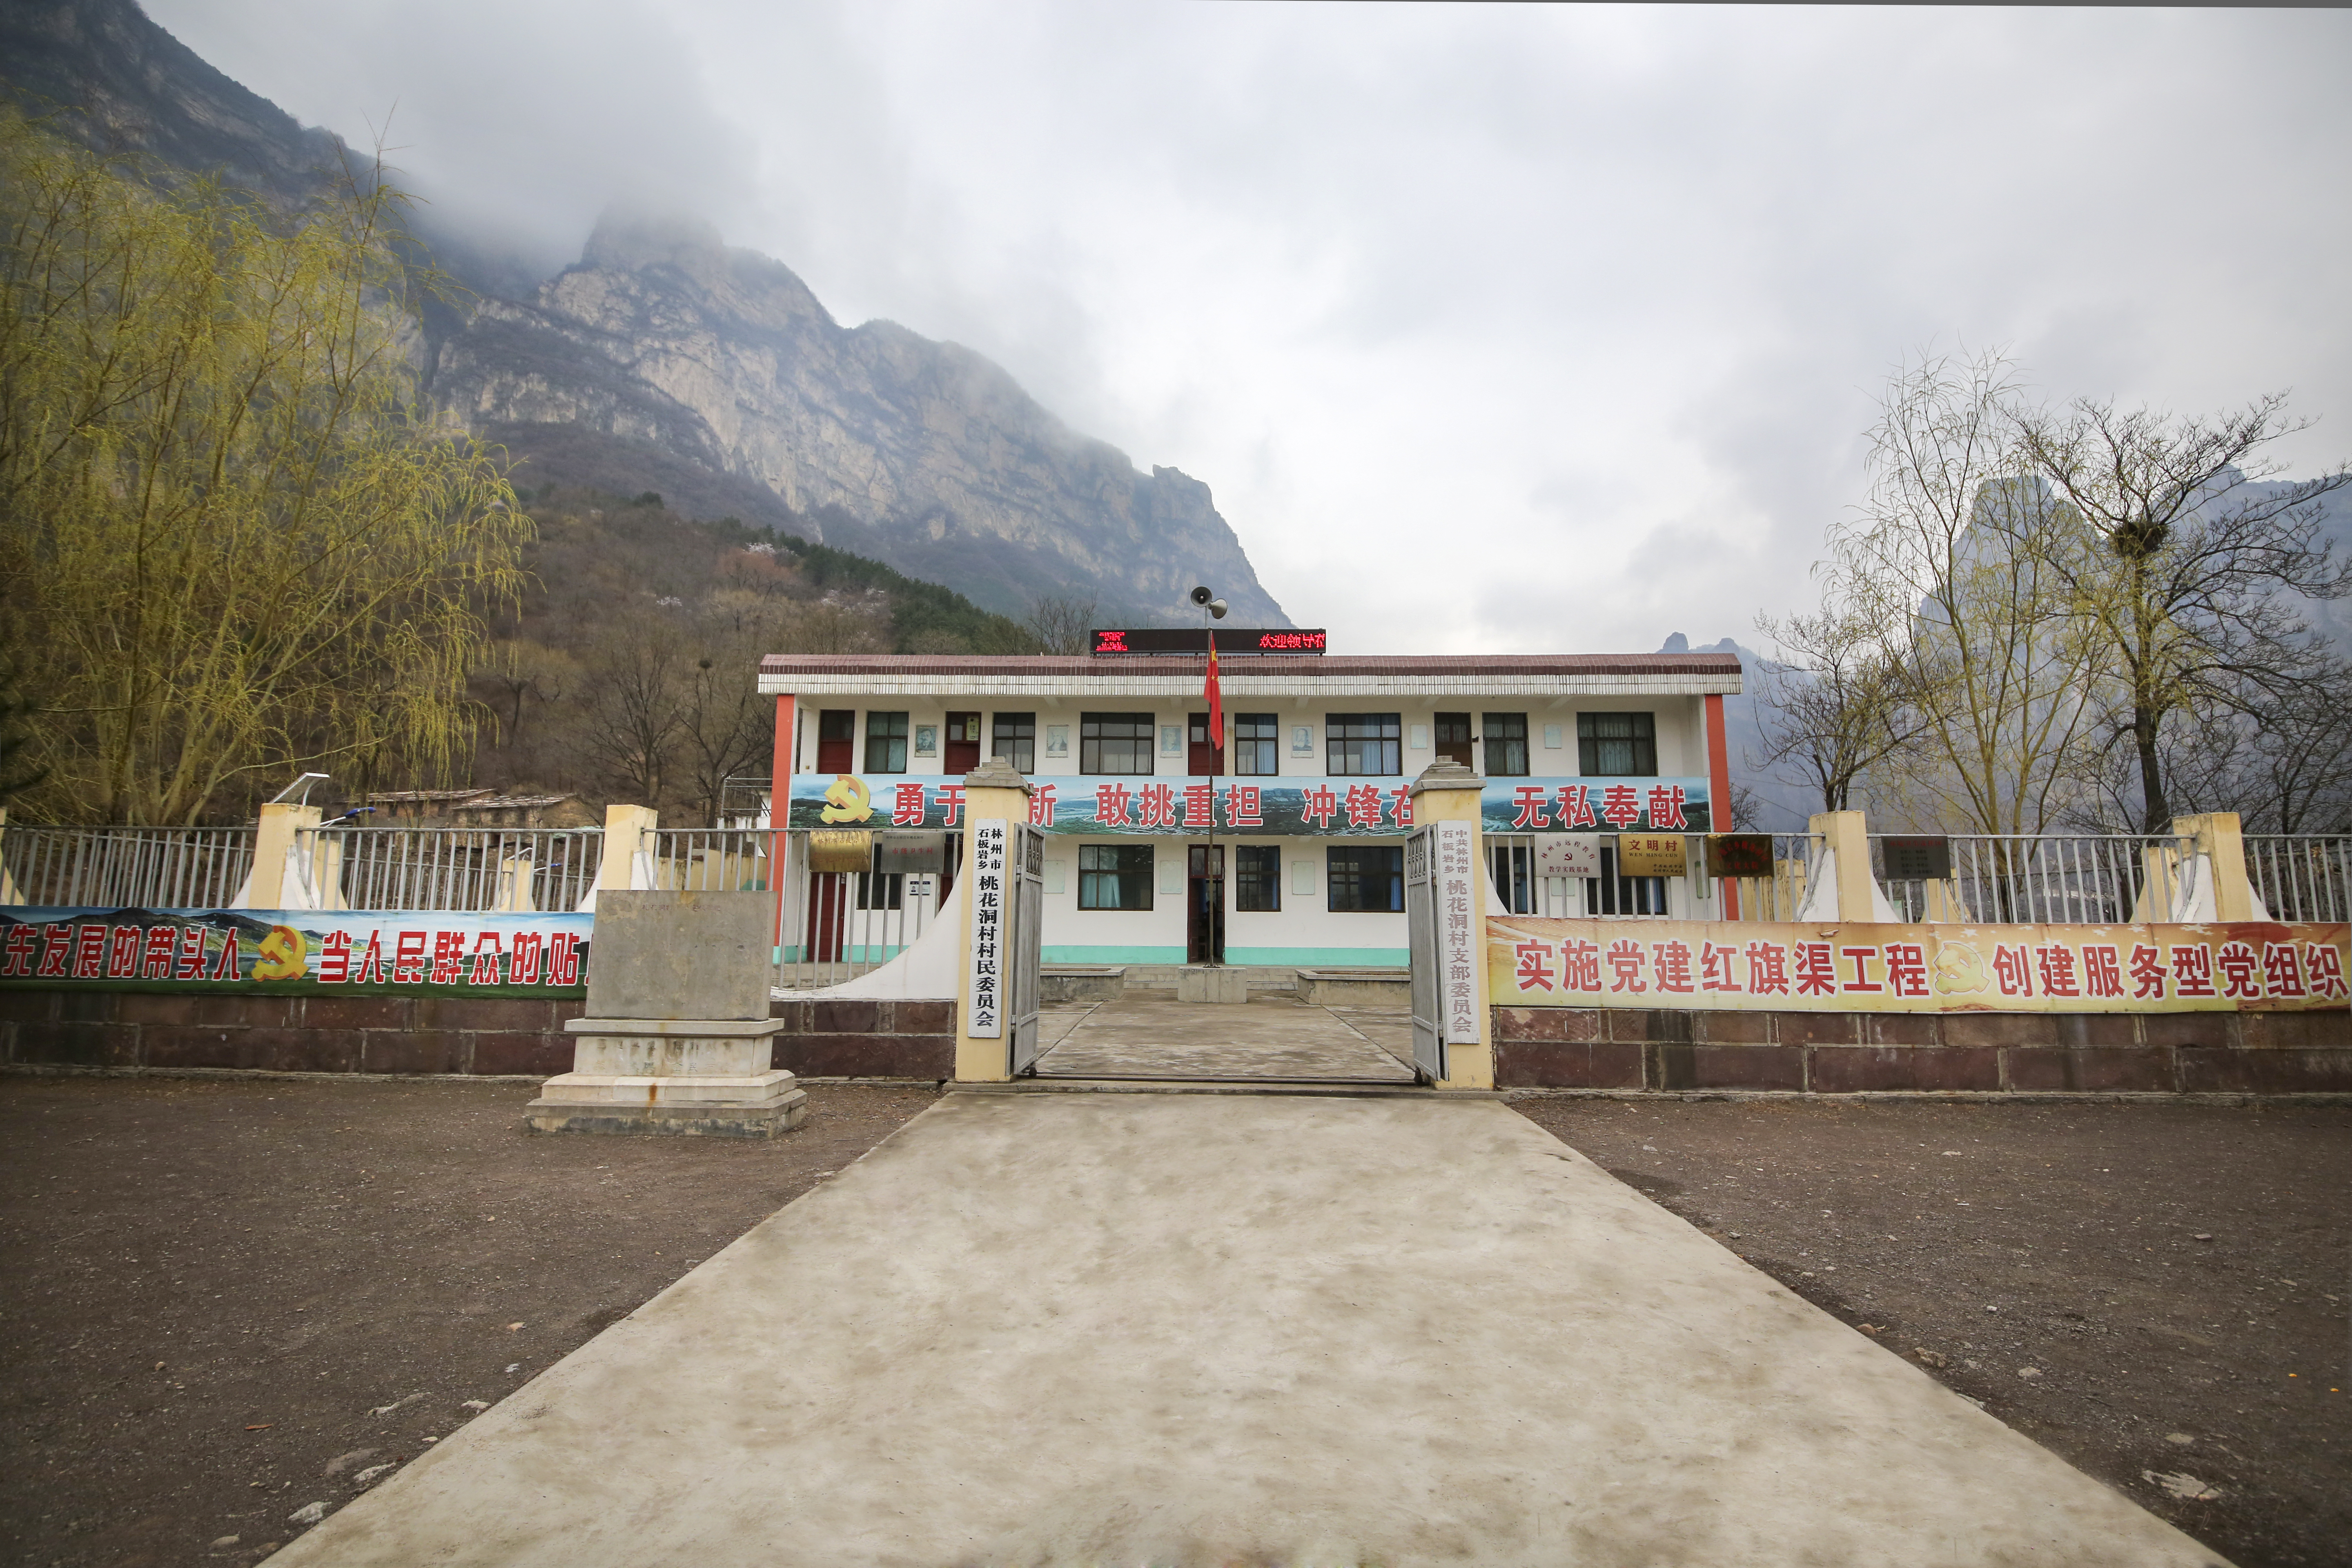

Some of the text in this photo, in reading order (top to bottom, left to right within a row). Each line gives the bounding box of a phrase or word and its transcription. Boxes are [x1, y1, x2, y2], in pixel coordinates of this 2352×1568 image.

[891, 782, 1688, 830] 勇于新 敢挑重担 冲锋在 无私奉献
[977, 829, 989, 870] 石板岩乡
[991, 828, 1002, 870] 林州市
[1441, 830, 1455, 873] 石板岩乡
[1456, 830, 1469, 874] 中共林州市
[1541, 840, 1596, 859] 林州市远程教育
[1628, 840, 1677, 852] 文明村
[0, 924, 593, 986] 先发展的带头人 当人民群众的贴
[975, 875, 998, 1027] 桃花洞村村民委员会
[1446, 880, 1473, 1033] 桃花洞村支部委员会
[1513, 937, 2350, 1000] 实施党建红旗渠工程 创建服务型党组织
